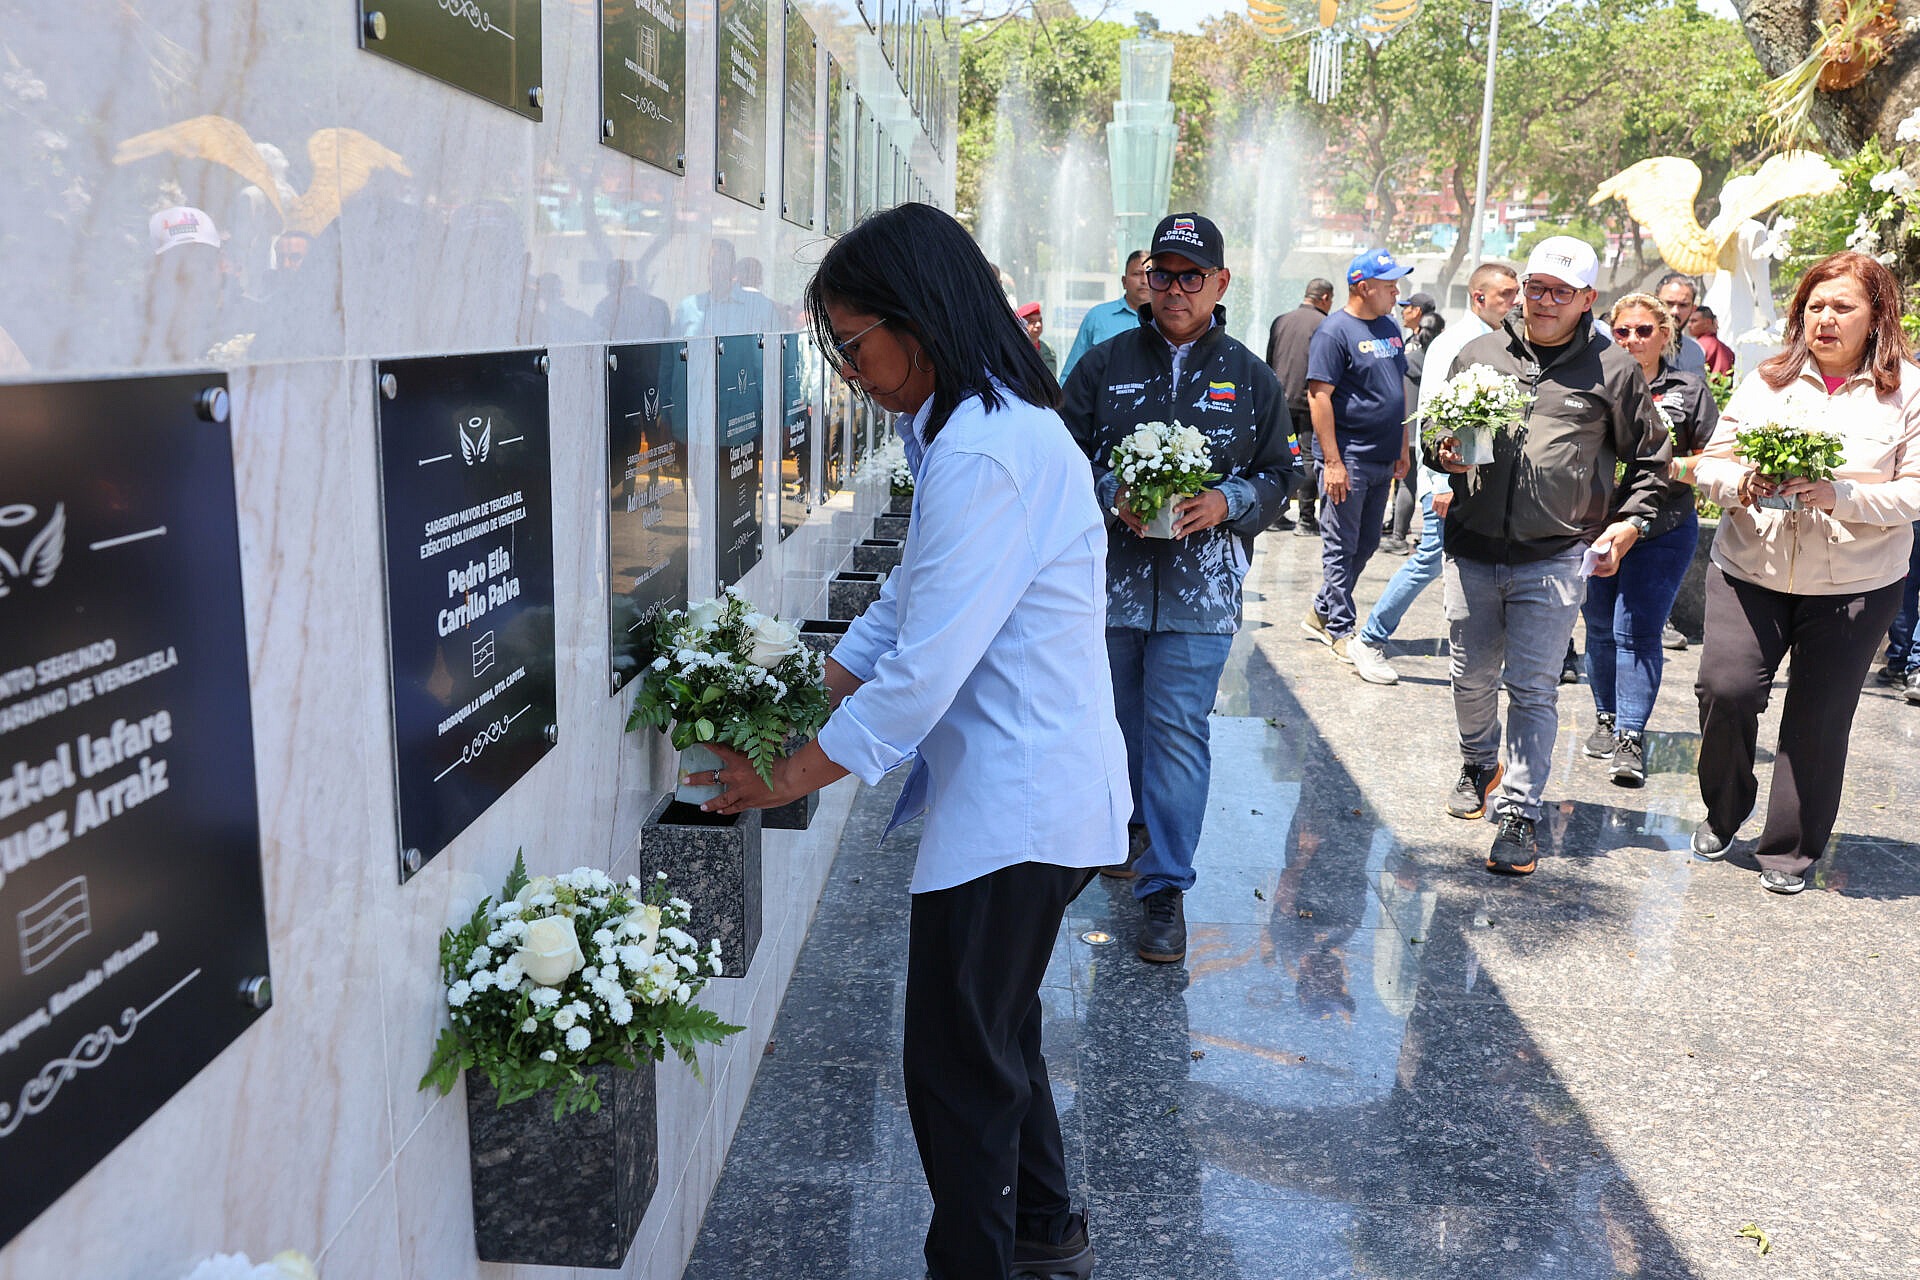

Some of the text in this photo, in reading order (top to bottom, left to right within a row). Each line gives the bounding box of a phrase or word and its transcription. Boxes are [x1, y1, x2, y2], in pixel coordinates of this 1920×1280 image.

[1166, 229, 1199, 239] OBRAS
[420, 506, 527, 560] EJÉRCITO BOLIVARIANO DE VENEZUELA
[425, 491, 524, 537] SARGENTO MAYOR DE TERCERA DEL
[447, 545, 511, 598] Pedro Elia
[437, 576, 521, 638] Carrillo Paiva
[36, 638, 117, 686] SEGUNDO
[67, 677, 95, 707] DE
[93, 646, 179, 696] VENEZUELA
[438, 703, 472, 737] PARROQUIA
[471, 698, 480, 713] LA
[506, 665, 526, 688] CAPITAL
[73, 755, 170, 837] Arraiz
